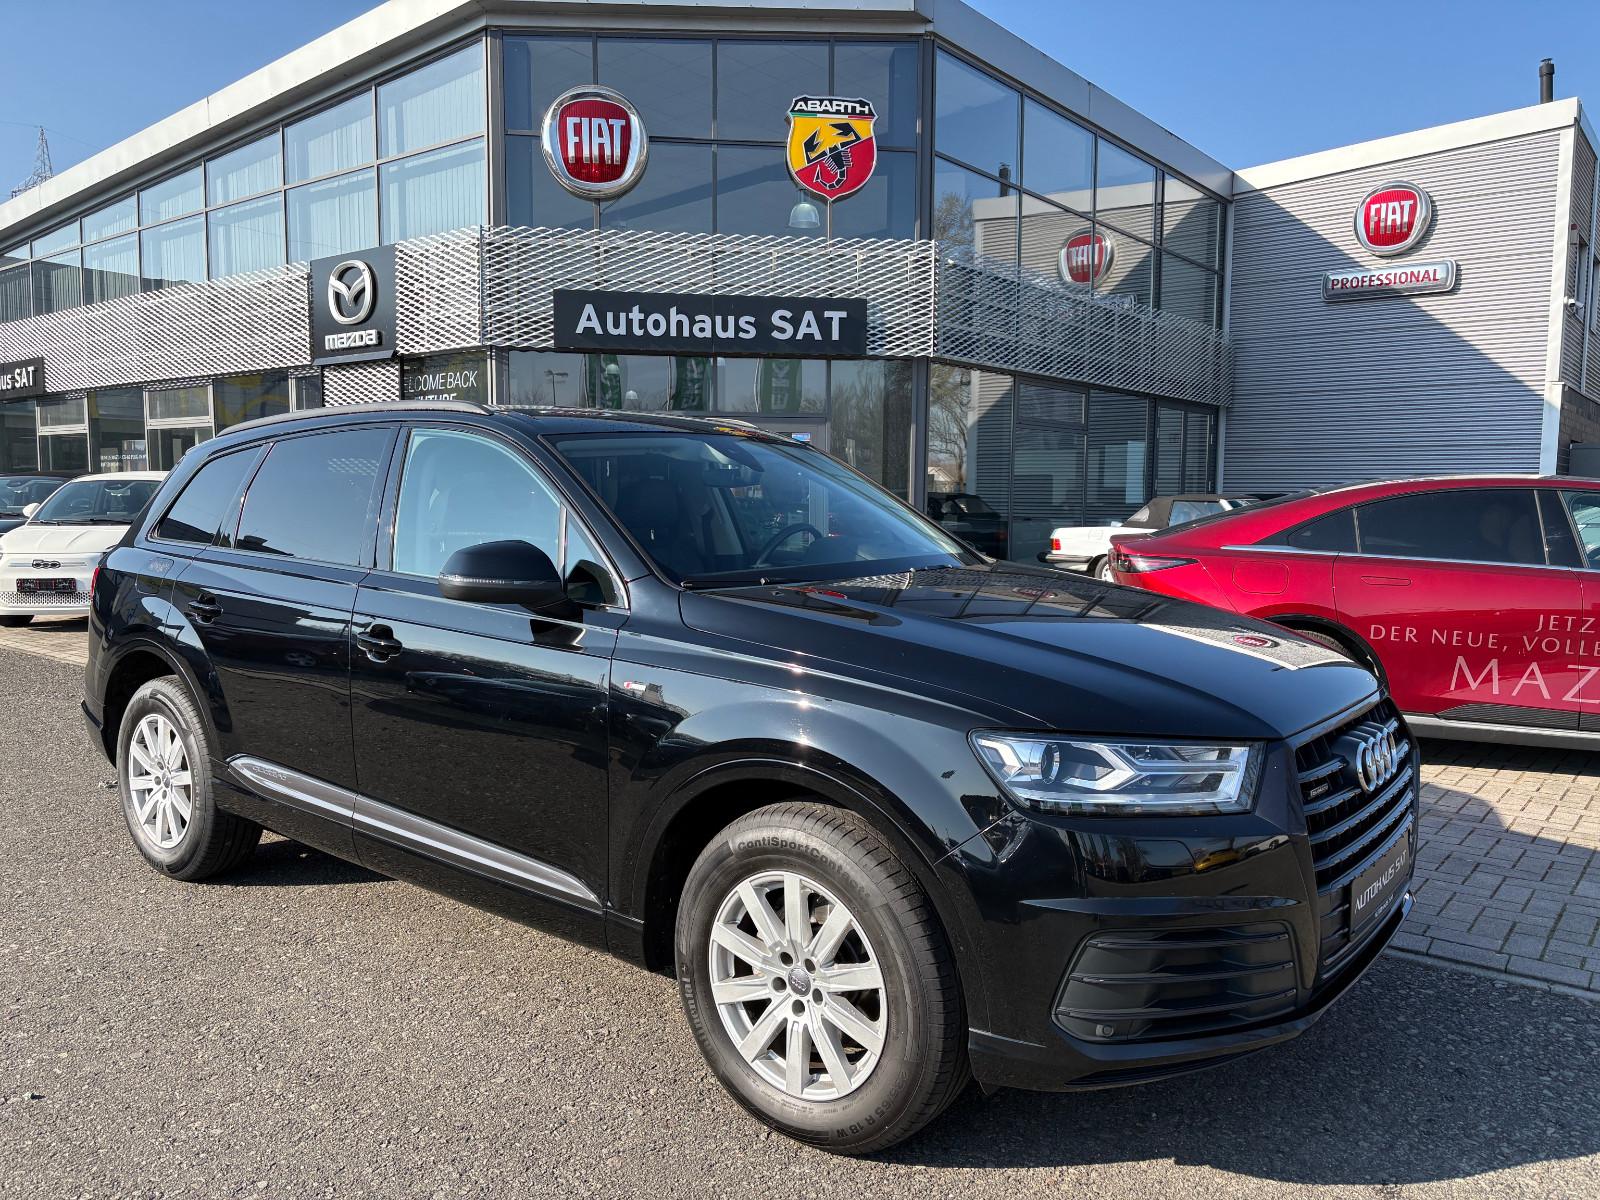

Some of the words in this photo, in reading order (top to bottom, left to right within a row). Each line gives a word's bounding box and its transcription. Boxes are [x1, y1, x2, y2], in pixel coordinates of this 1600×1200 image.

[793, 101, 870, 115] ABARTH
[566, 116, 626, 165] FIAT
[1369, 199, 1414, 236] FIAT
[1330, 268, 1441, 291] PROFESSIONAL
[575, 303, 757, 340] Autohaus
[770, 308, 848, 342] SAT
[0, 374, 12, 390] us
[14, 366, 35, 389] SAT
[446, 370, 478, 389] BACK
[1369, 624, 1418, 643] DER
[1431, 629, 1508, 652] NEUE,
[1450, 655, 1600, 704] MAZ
[1355, 864, 1395, 914] AUTOHAUS
[1395, 849, 1407, 873] SAT
